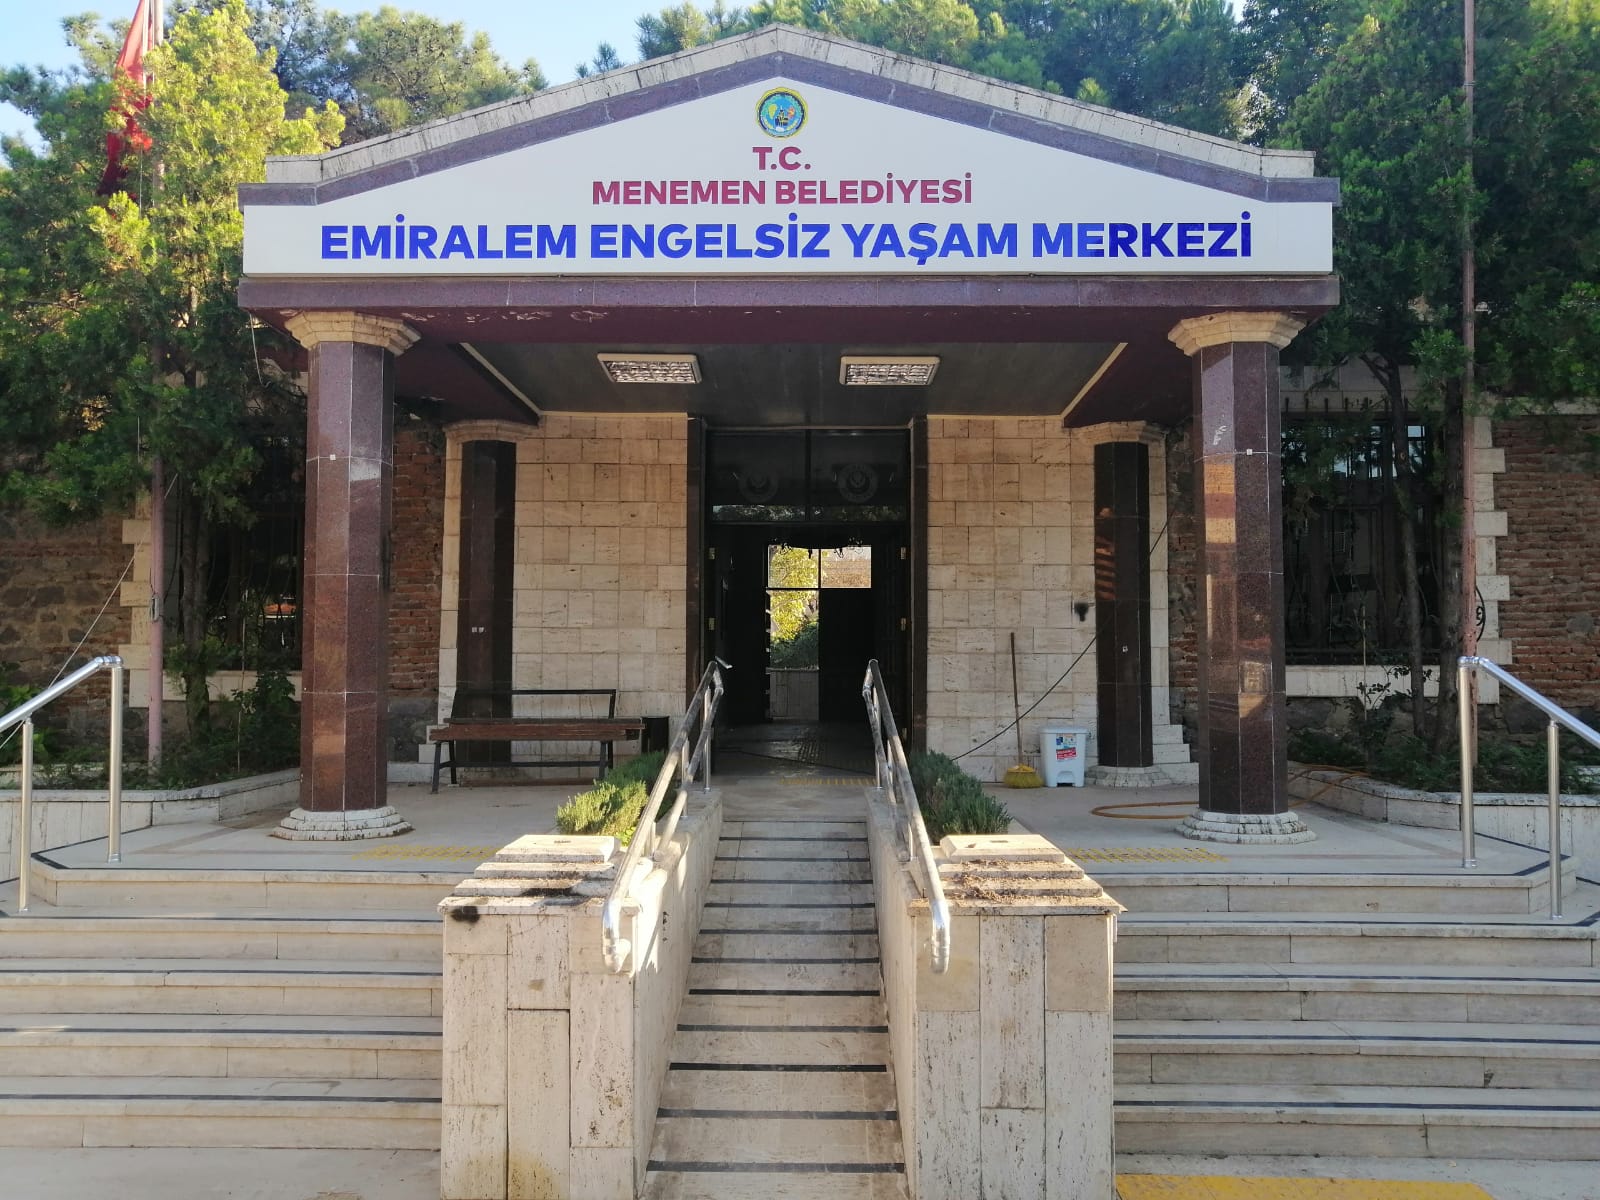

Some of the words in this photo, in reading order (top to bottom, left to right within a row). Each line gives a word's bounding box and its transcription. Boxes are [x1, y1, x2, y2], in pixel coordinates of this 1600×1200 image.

[753, 147, 811, 169] T.C.
[593, 181, 766, 205] MENEMEN
[776, 172, 972, 204] BELEDİYESİ
[321, 213, 577, 260] EMİRALEM
[590, 212, 831, 259] ENGELSİZ
[842, 222, 1019, 265] YAŞAM
[1032, 211, 1252, 258] MERKEZİ
